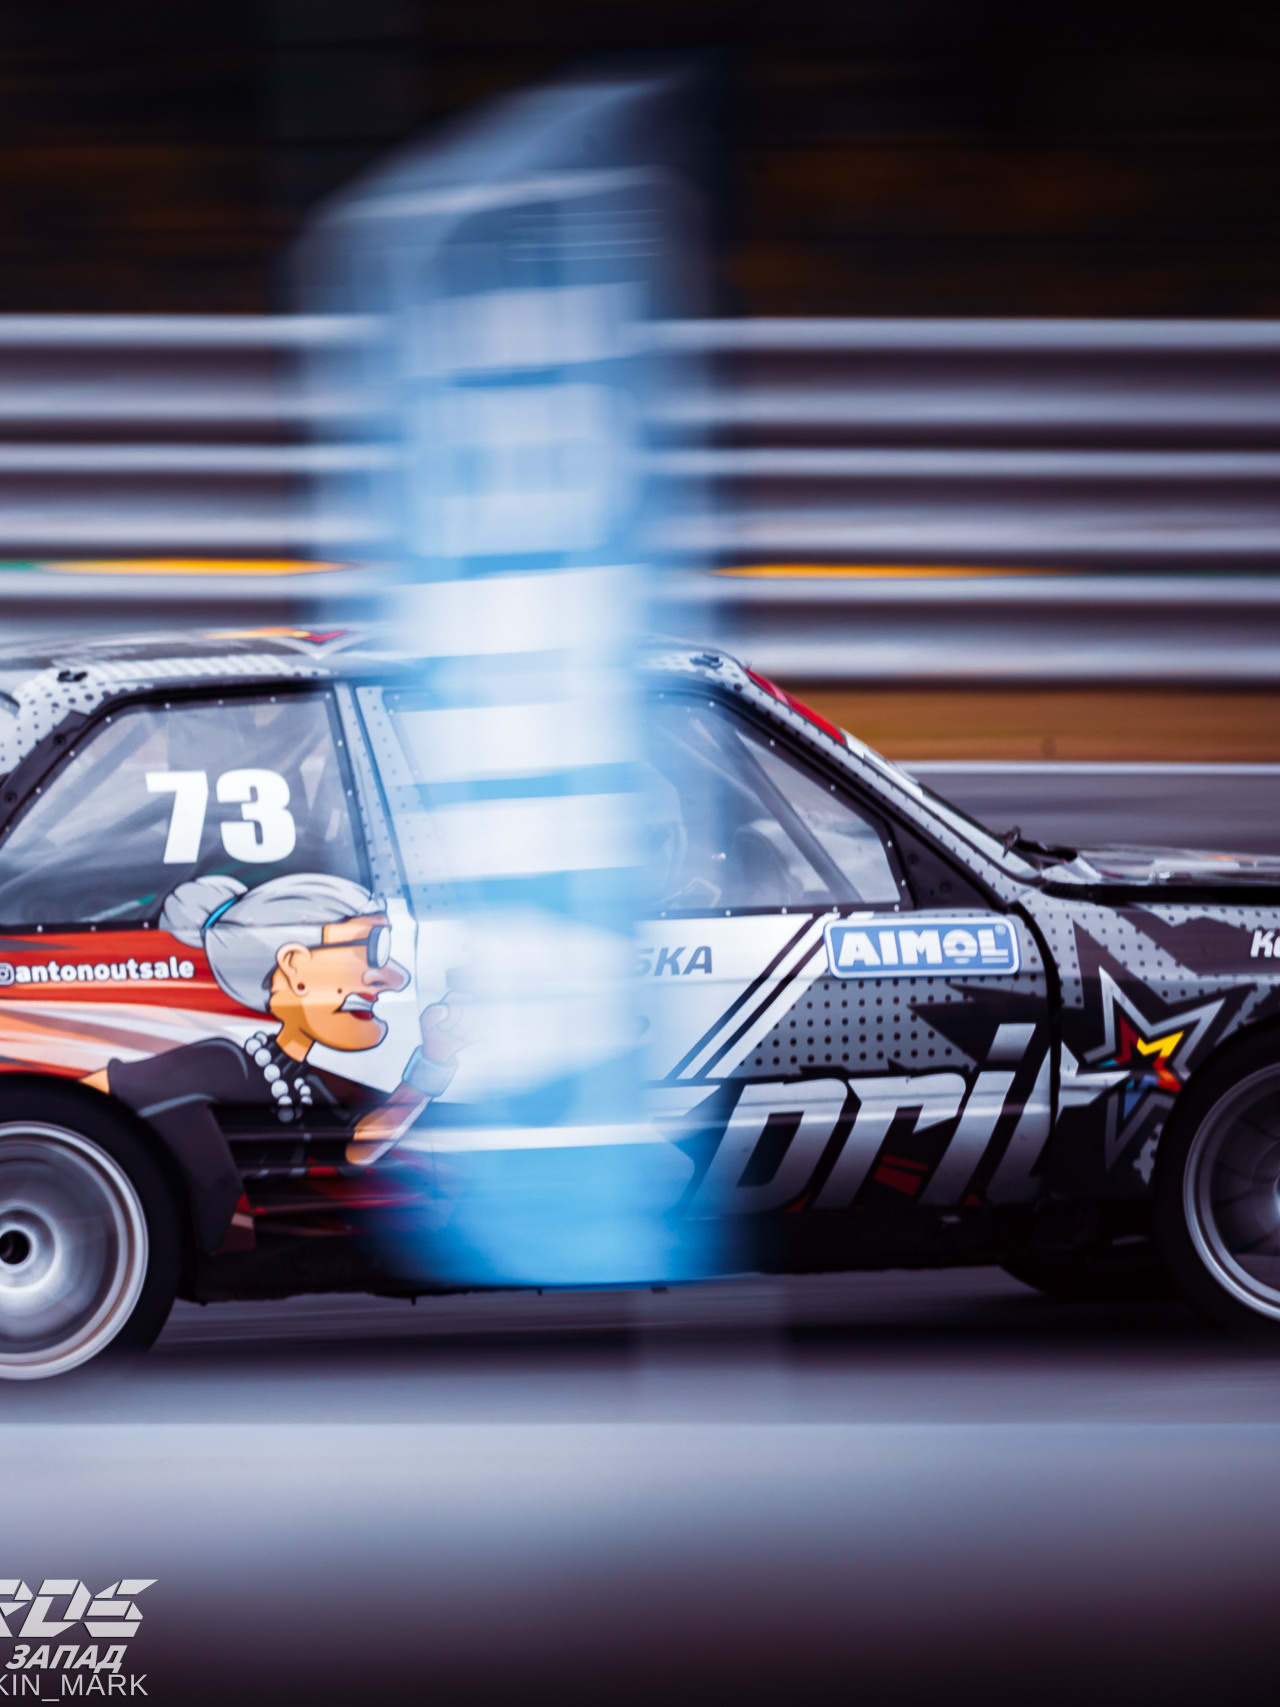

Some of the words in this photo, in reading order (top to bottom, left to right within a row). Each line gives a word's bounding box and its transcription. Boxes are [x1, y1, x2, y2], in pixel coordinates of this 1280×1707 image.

[145, 768, 297, 864] 73
[837, 928, 1010, 967] AIMOL
[14, 955, 195, 982] antonoutsale
